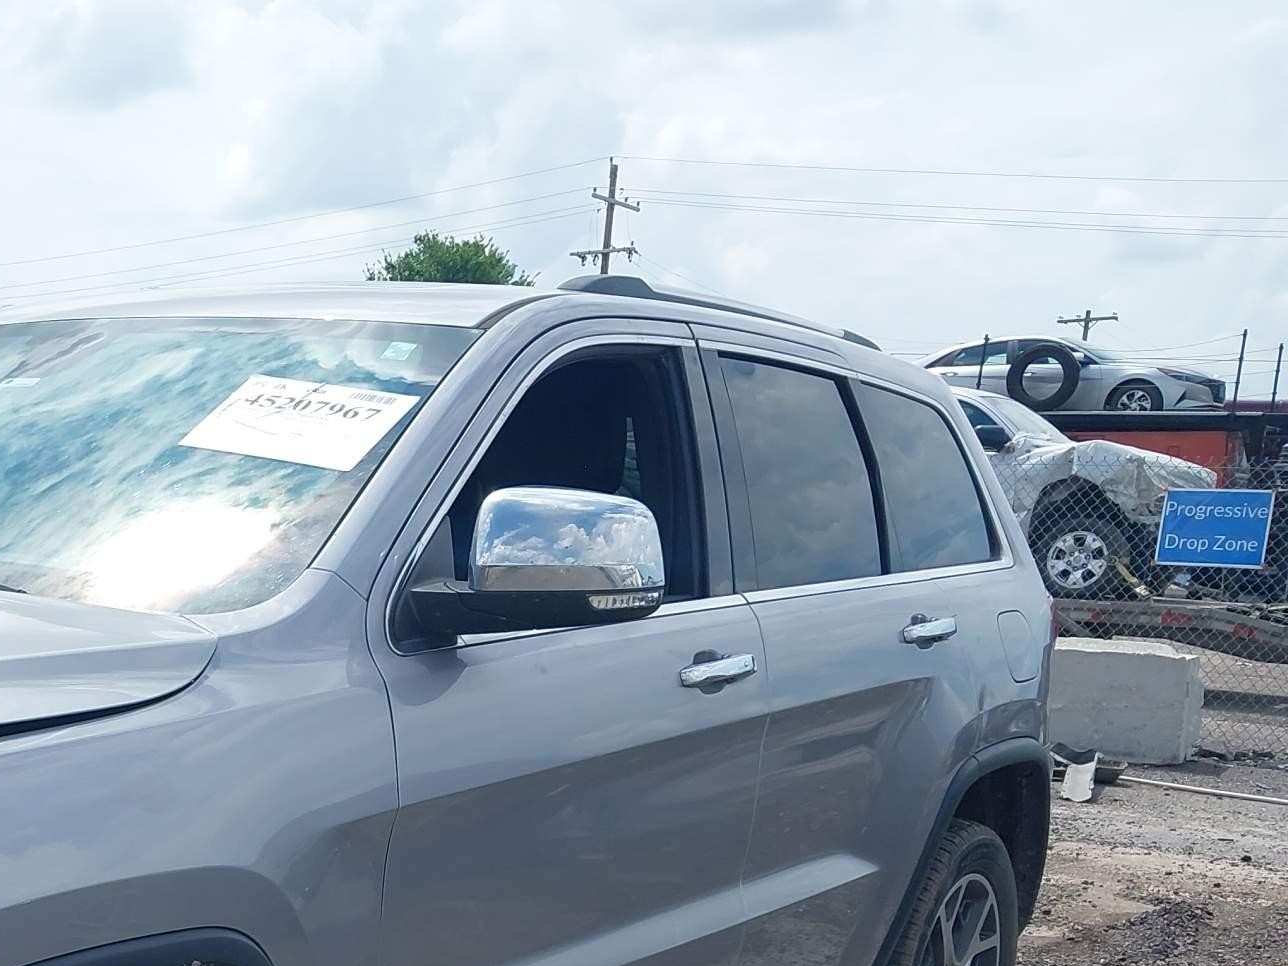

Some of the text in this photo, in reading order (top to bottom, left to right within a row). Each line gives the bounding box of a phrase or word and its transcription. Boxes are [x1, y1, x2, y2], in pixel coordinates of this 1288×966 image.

[244, 393, 383, 422] 45207967
[1165, 501, 1269, 520] Progressive
[1164, 533, 1258, 553] Drop Zone
